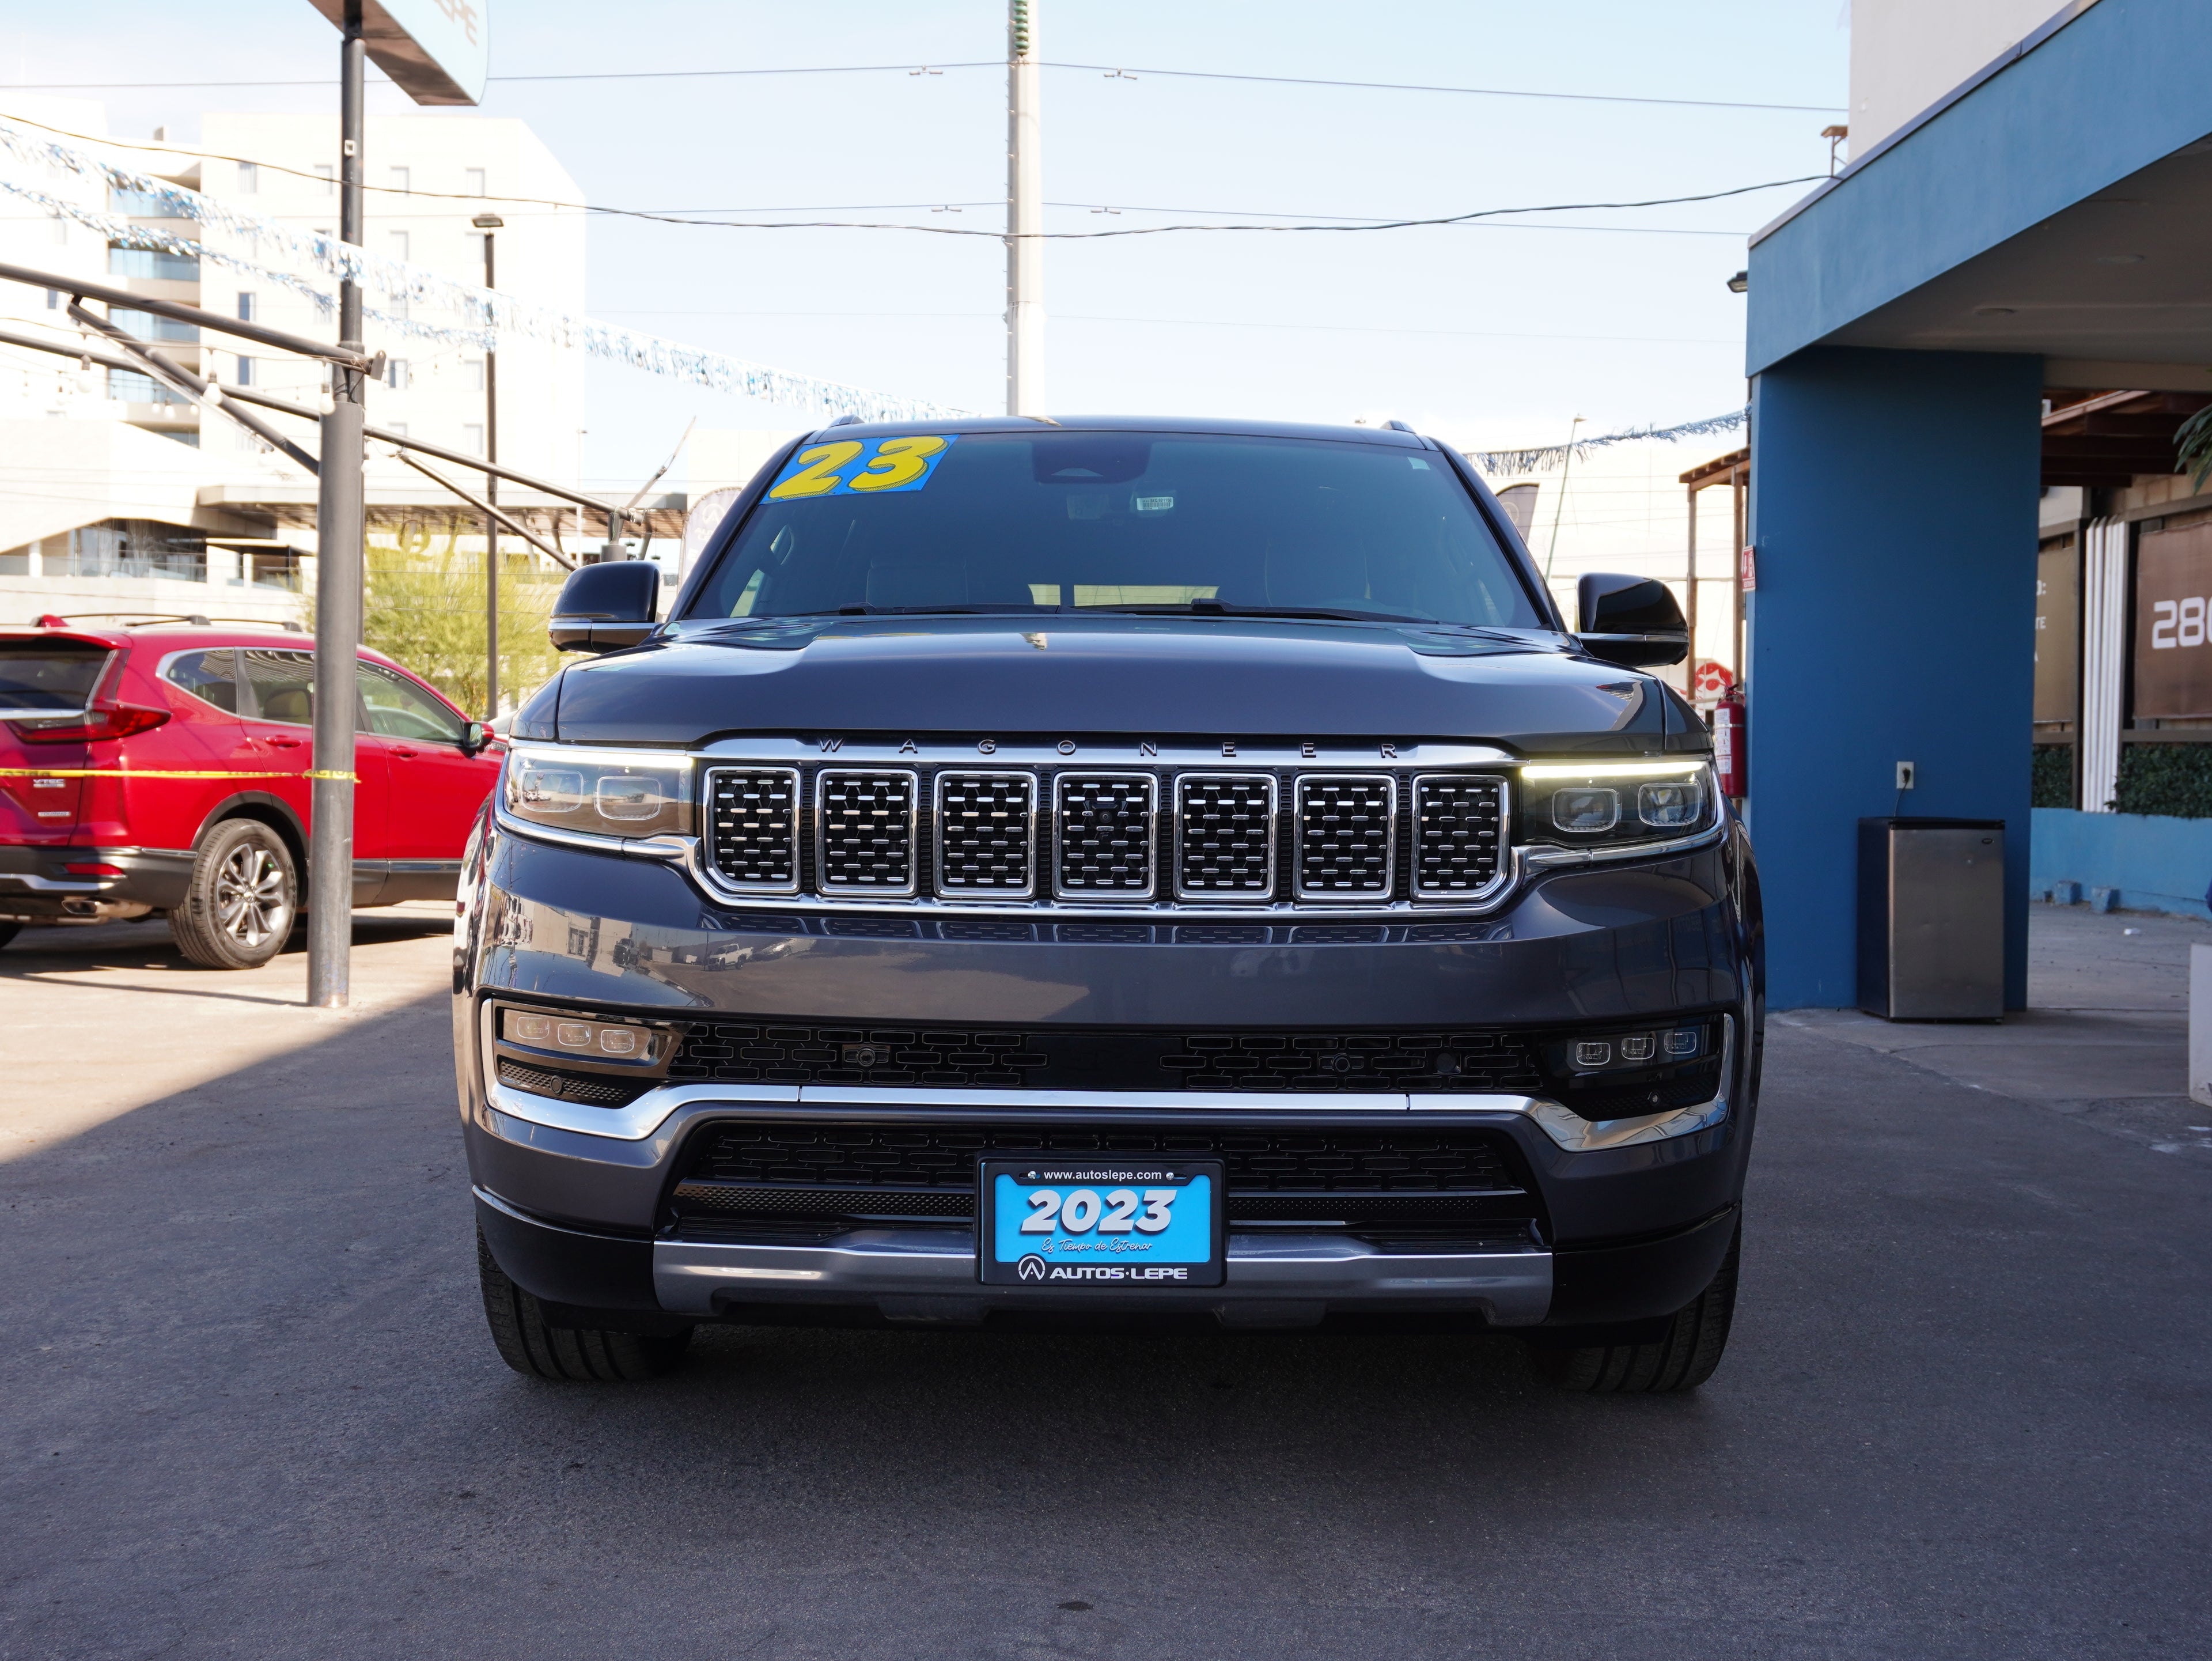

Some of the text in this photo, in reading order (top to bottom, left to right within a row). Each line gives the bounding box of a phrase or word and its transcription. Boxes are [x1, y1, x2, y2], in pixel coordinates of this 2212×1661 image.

[769, 436, 950, 499] 23
[2152, 596, 2212, 649] 28
[818, 739, 1398, 759] WAGONEER
[1044, 1170, 1162, 1182] www.autoslepe.com
[1021, 1189, 1177, 1232] 2023
[1041, 1237, 1153, 1254] Es Tiempo de Estrenar
